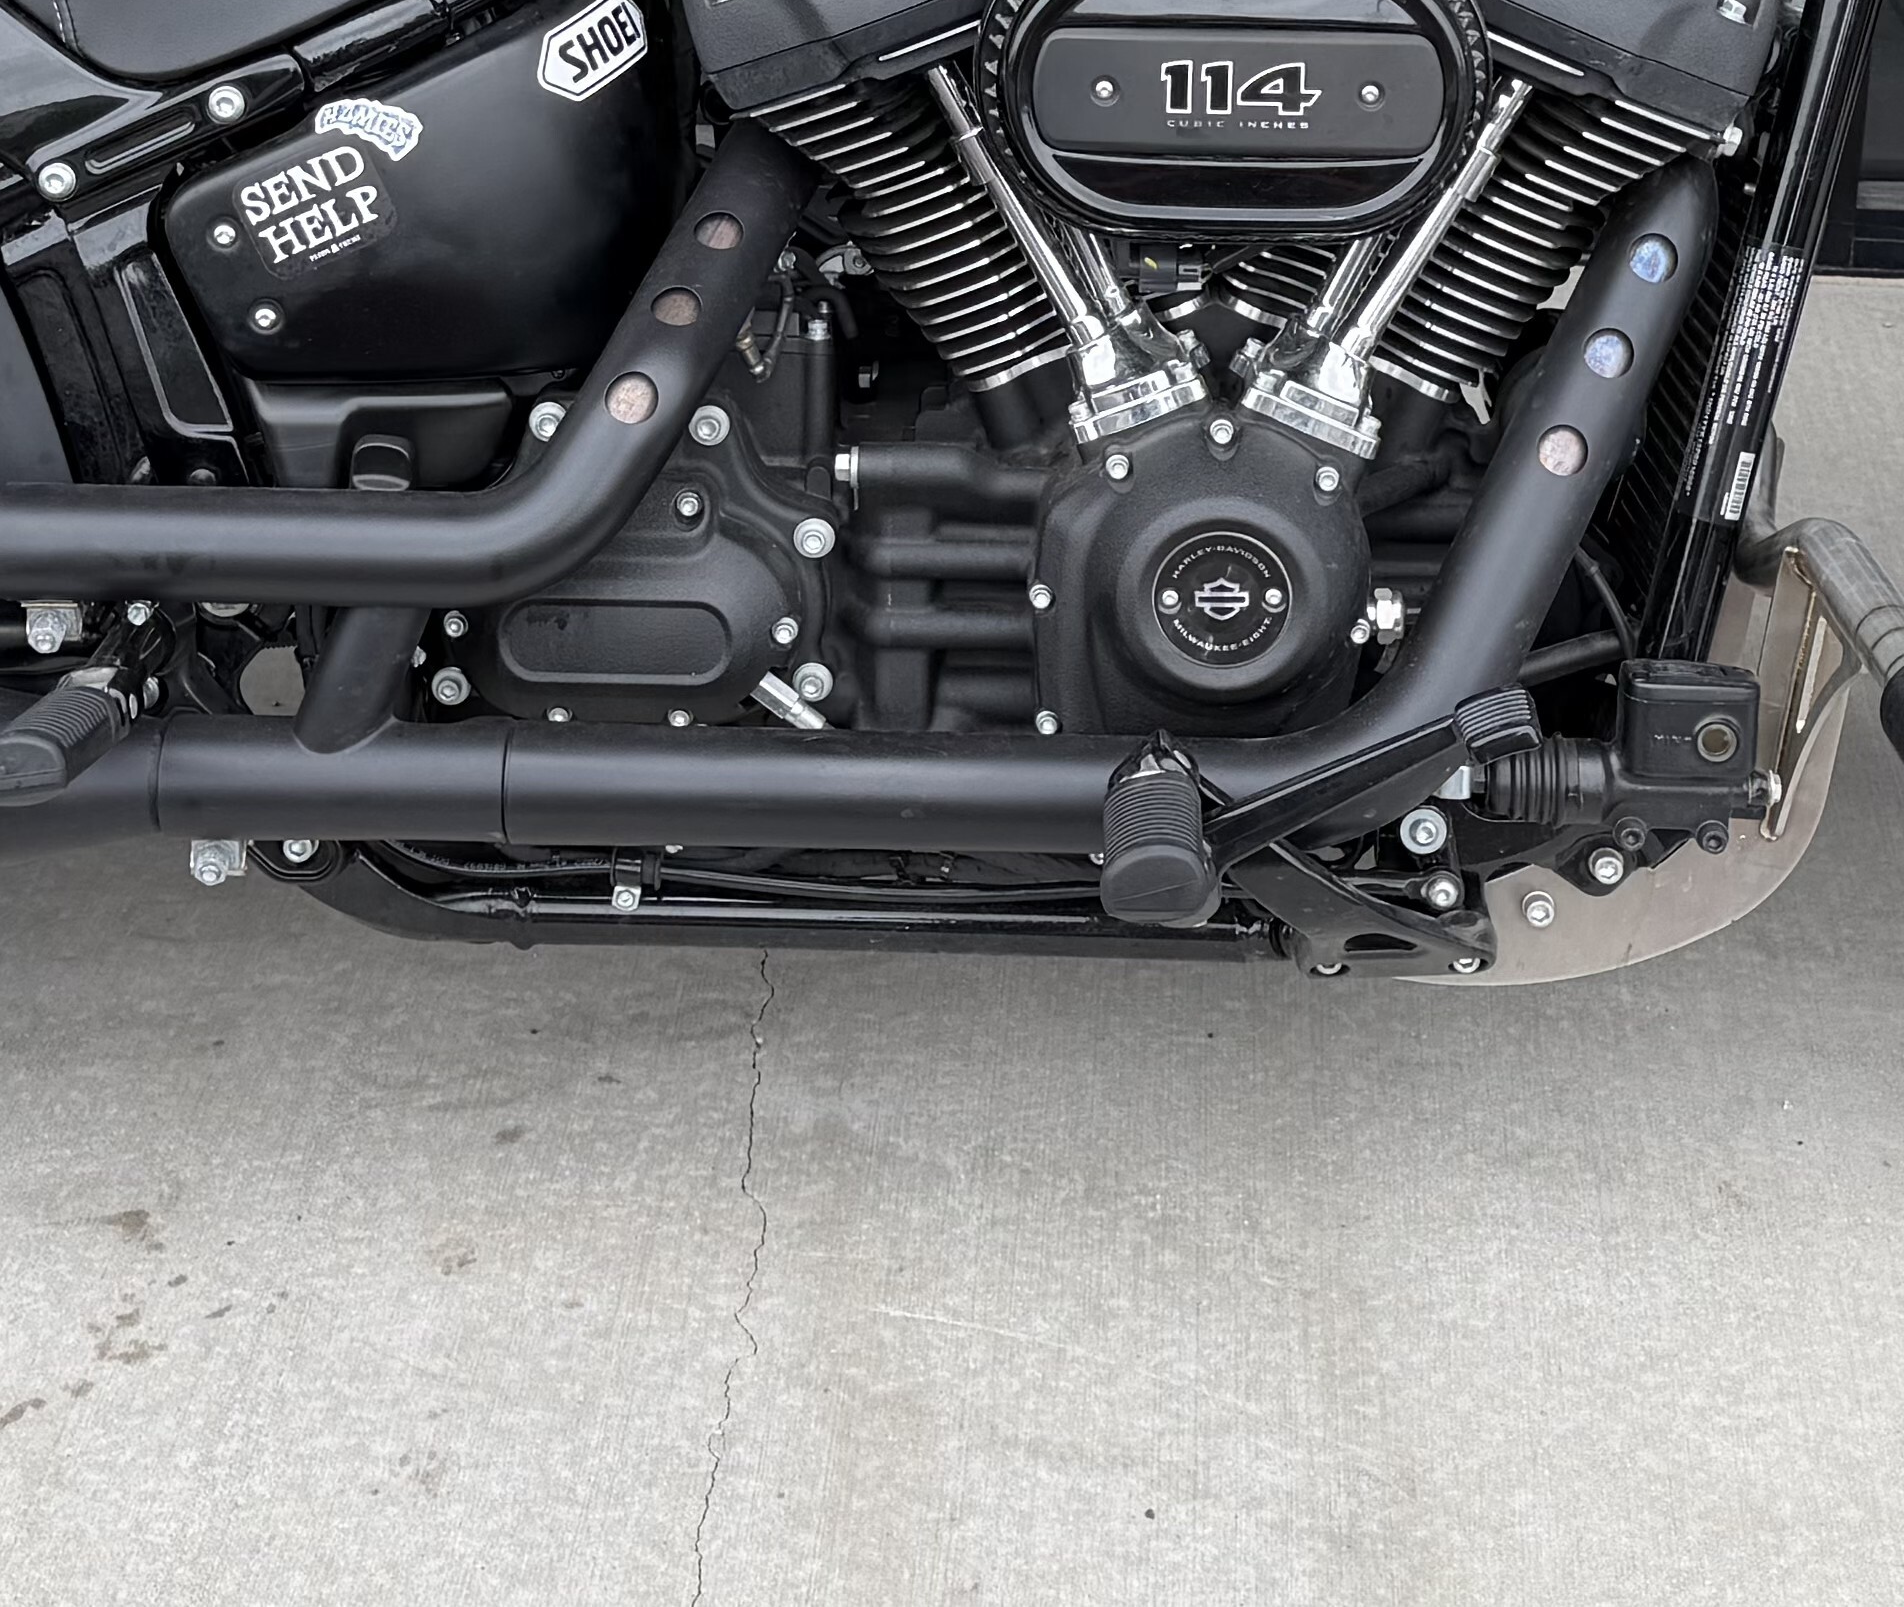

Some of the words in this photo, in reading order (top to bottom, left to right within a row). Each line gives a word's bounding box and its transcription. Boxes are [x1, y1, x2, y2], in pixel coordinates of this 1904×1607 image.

[558, 0, 642, 85] SHOEI
[1161, 60, 1322, 115] 114
[1167, 119, 1225, 128] CUBIC
[1240, 120, 1309, 129] INCHES
[240, 146, 366, 226] SEND
[257, 185, 380, 264] HELP
[1171, 545, 1271, 580] HARLEY-DAVIDSON
